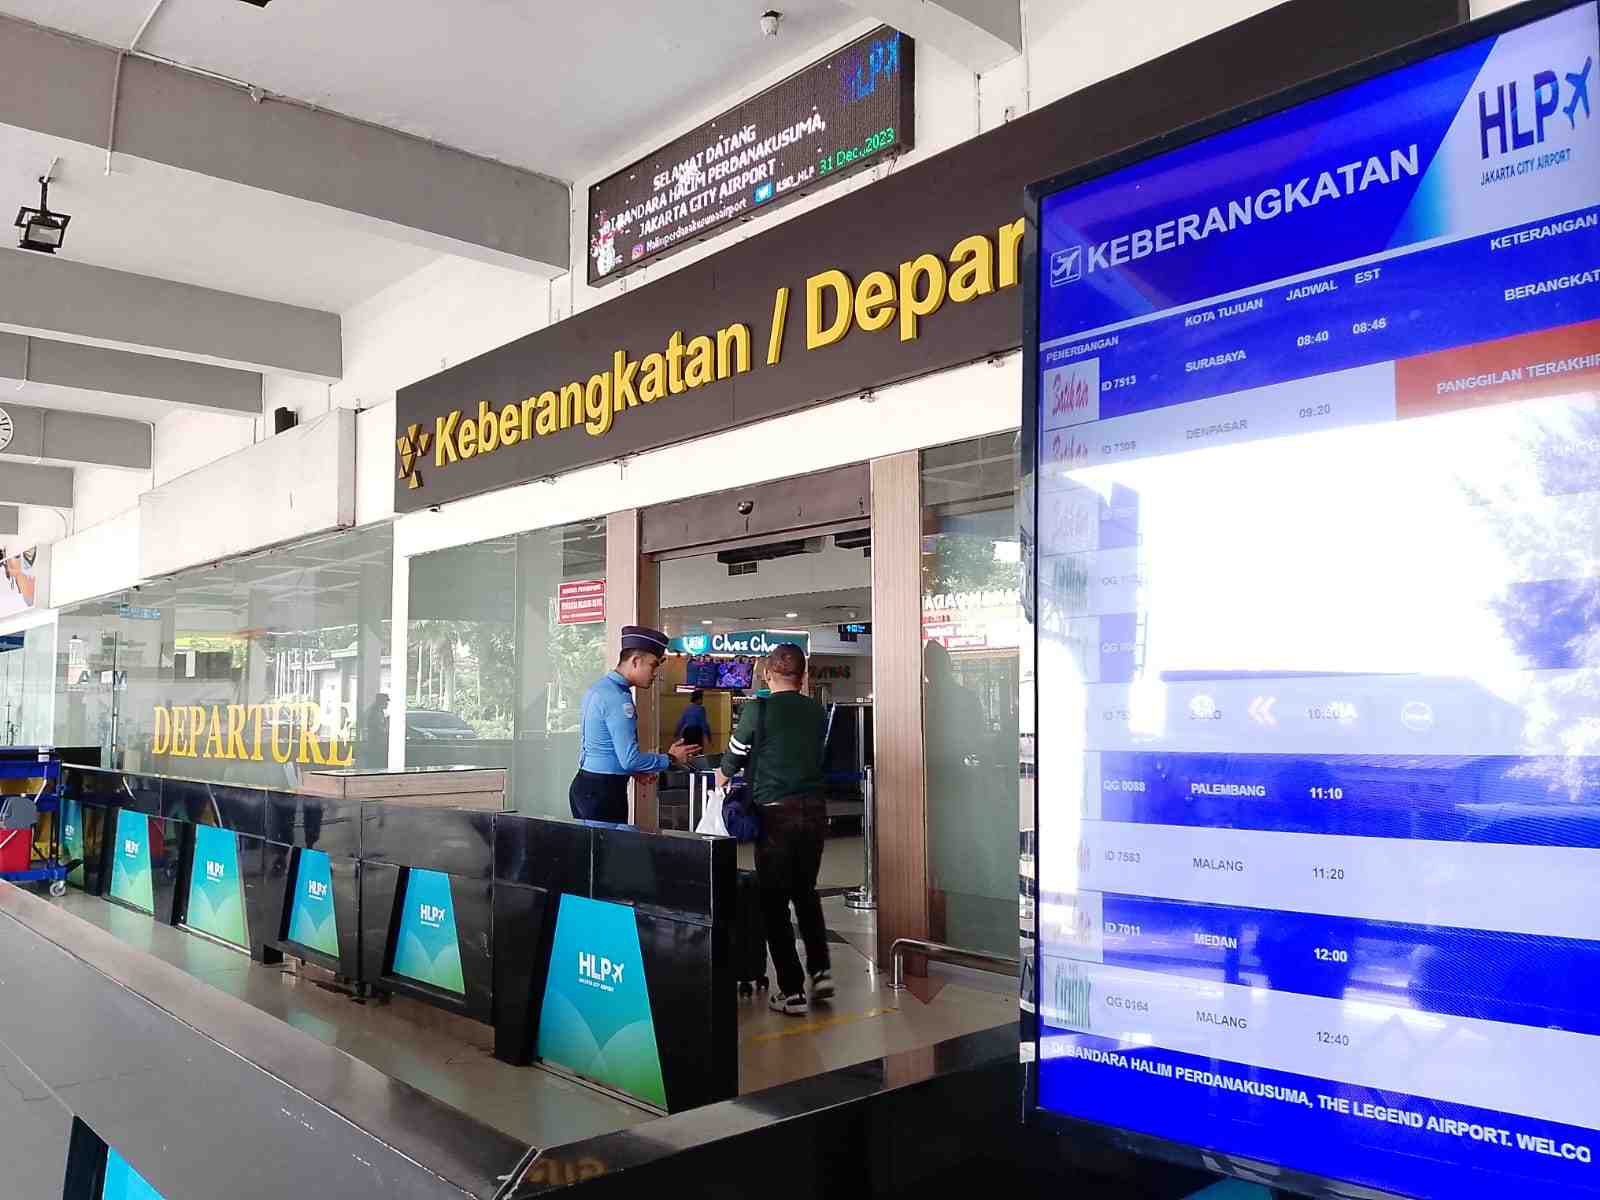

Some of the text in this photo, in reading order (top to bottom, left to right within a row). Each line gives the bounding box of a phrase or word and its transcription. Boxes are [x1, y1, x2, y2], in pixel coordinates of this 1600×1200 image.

[1478, 70, 1560, 160] HLP
[653, 124, 756, 191] SELAMAT DATANG
[708, 113, 826, 185] PERDANAKUSUMA,
[1480, 148, 1572, 187] JAKARTA CITY AIRPORT
[638, 158, 776, 237] JAKARTA CITY AIRPORT
[1087, 144, 1420, 273] KEBERANGKATAN
[1490, 213, 1598, 251] KETERANGAN
[1354, 267, 1381, 284] EST
[1286, 279, 1338, 301] JADWAL
[1185, 298, 1264, 327] KOTA TUJUAN
[1296, 330, 1329, 348] 08:40
[1185, 350, 1247, 372] SURABAYA
[1101, 375, 1137, 392] ID 7513
[1436, 368, 1522, 395] PANGGILAN
[434, 322, 752, 468] Keberangkatan
[1186, 419, 1248, 440] DENPASAR
[152, 701, 356, 766] DEPARTURE
[1191, 783, 1266, 798] PALEMBANG
[1309, 786, 1343, 801] 11:10
[1193, 857, 1244, 873] MALANG
[1312, 867, 1345, 881] 11:20
[1194, 932, 1237, 950] MEDAN
[579, 951, 612, 981] HLP
[1314, 948, 1348, 963] 12:00
[1106, 995, 1123, 1009] QG
[1196, 1010, 1248, 1030] MALANG
[1317, 1031, 1350, 1047] 12:40
[1130, 1058, 1173, 1078] HALIM
[1175, 1066, 1314, 1109] PERDANAKUSUMA,
[1317, 1094, 1350, 1114] THE
[1352, 1101, 1424, 1129] LEGEND
[1425, 1115, 1513, 1147] AIRPORT.
